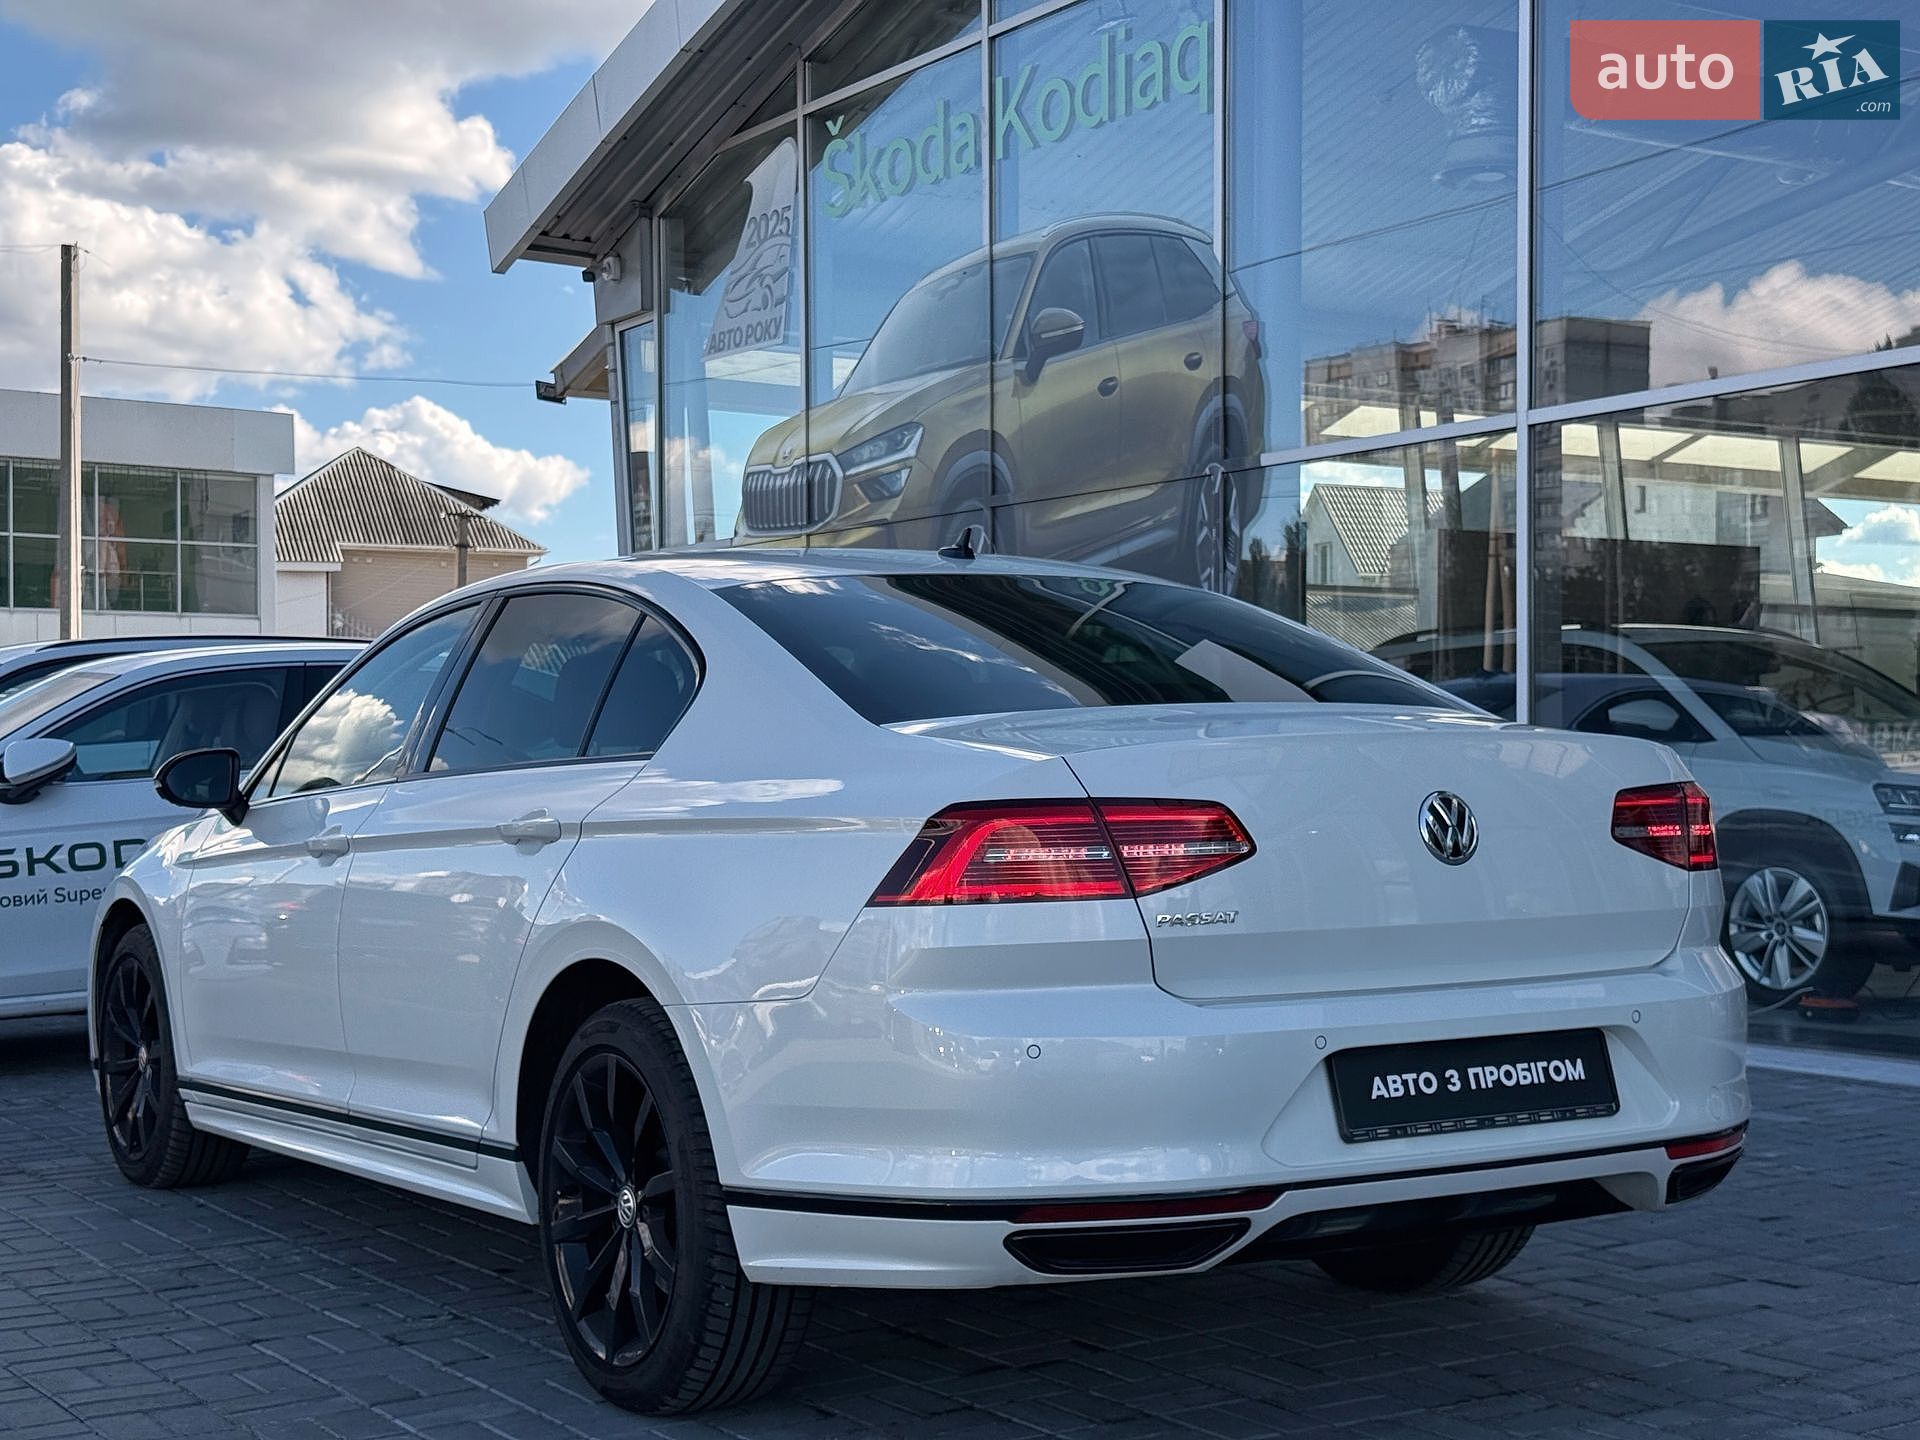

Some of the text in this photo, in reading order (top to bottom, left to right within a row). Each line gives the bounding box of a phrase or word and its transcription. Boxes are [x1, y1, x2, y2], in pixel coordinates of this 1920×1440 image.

[822, 20, 1213, 218] Škoda Kodiaq
[745, 204, 791, 249] 2025
[708, 316, 783, 354] АВТО РОКУ
[54, 887, 107, 905] Supe
[1156, 911, 1239, 928] PASSAT
[1371, 1070, 1438, 1100] АВТО
[1467, 1058, 1586, 1091] ПРОБІГОМ
